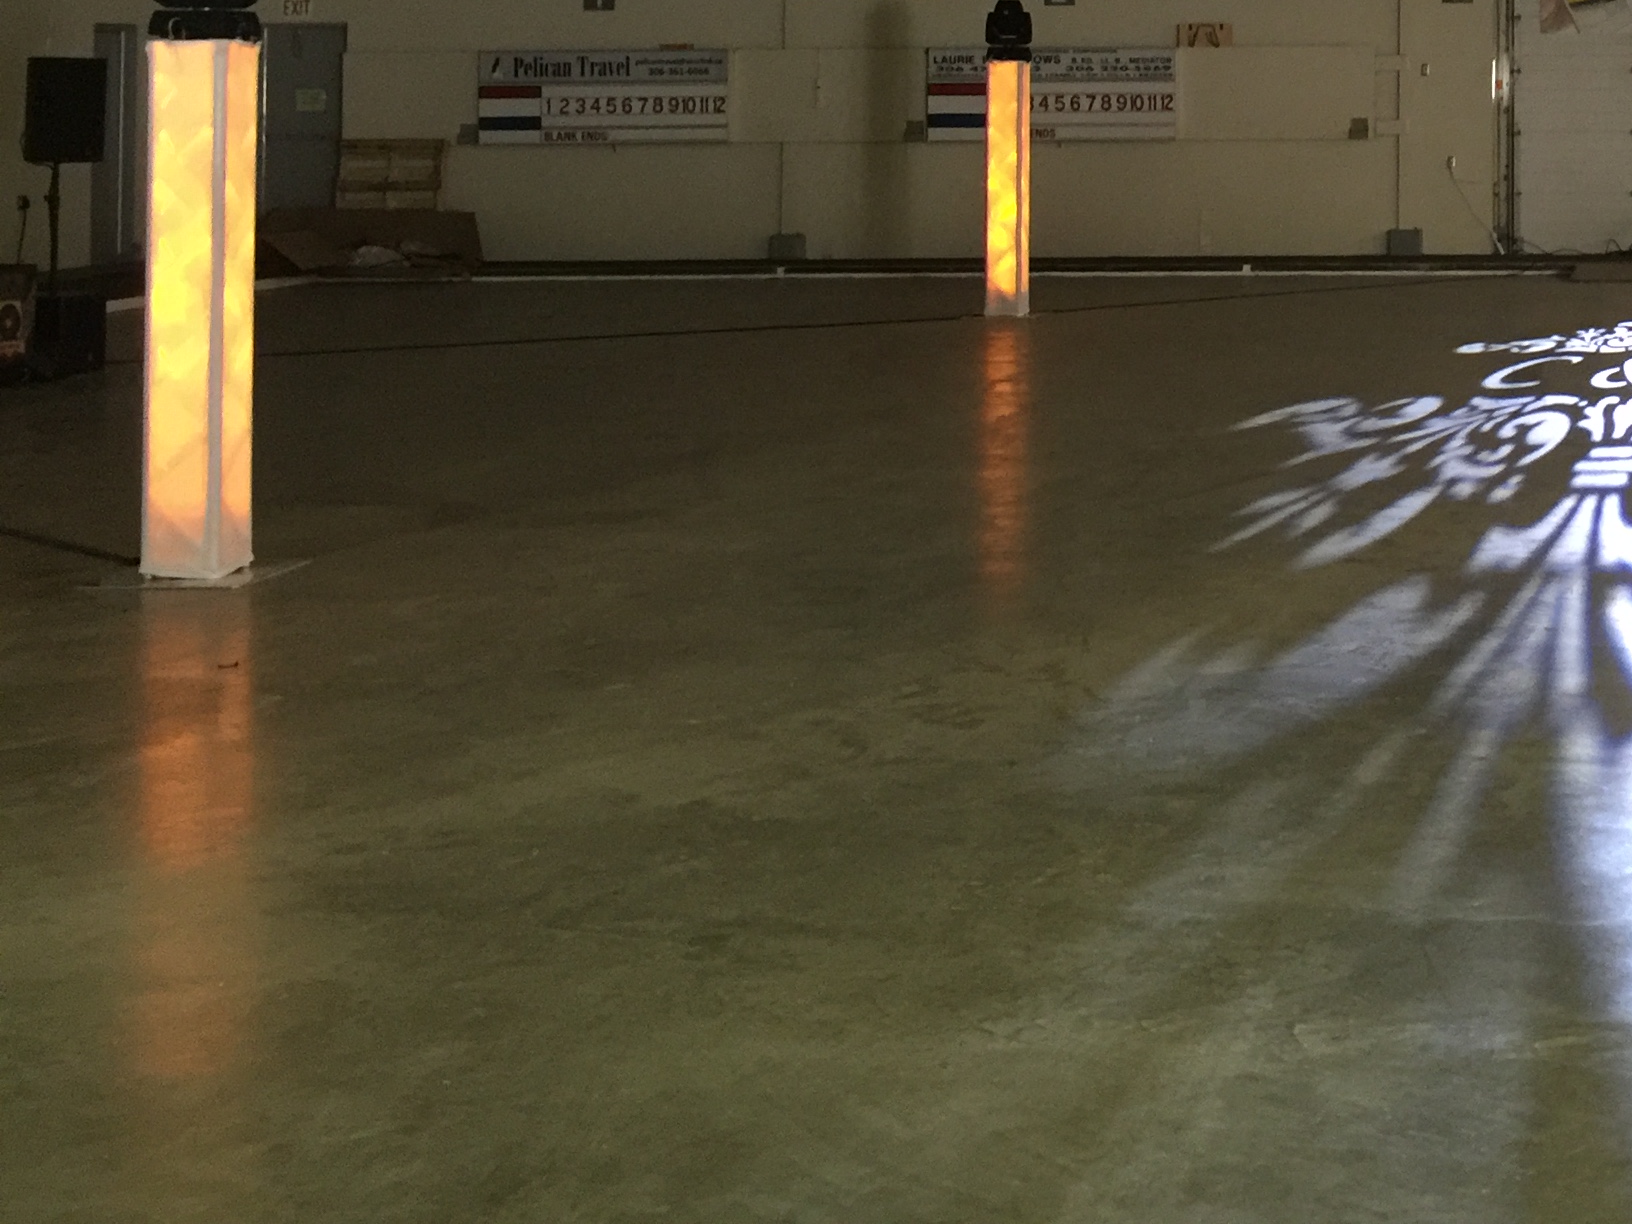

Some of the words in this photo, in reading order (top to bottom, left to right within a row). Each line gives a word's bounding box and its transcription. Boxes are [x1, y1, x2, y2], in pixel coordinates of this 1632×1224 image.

[283, 0, 310, 16] EXIT
[513, 56, 572, 77] Pelican
[577, 55, 630, 77] Travel
[933, 55, 975, 65] LAURIE
[560, 97, 569, 114] 2
[575, 97, 586, 114] 3
[590, 97, 601, 114] 4
[606, 97, 617, 114] 5
[621, 97, 632, 114] 6
[639, 97, 649, 114] 7
[653, 97, 663, 114] 8
[668, 97, 679, 114] 9
[682, 97, 696, 114] 10
[700, 97, 709, 114] 11
[713, 97, 726, 114] 12
[1038, 96, 1049, 112] 4
[1055, 96, 1066, 112] 5
[1070, 96, 1081, 112] 6
[1086, 96, 1096, 112] 7
[1101, 96, 1112, 112] 8
[1117, 96, 1127, 112] 9
[1130, 96, 1144, 112] 10
[1149, 96, 1157, 112] 11
[1161, 96, 1174, 112] 12
[544, 132, 579, 142] BLANK
[582, 132, 608, 142] ENDS
[1482, 356, 1583, 389] C
